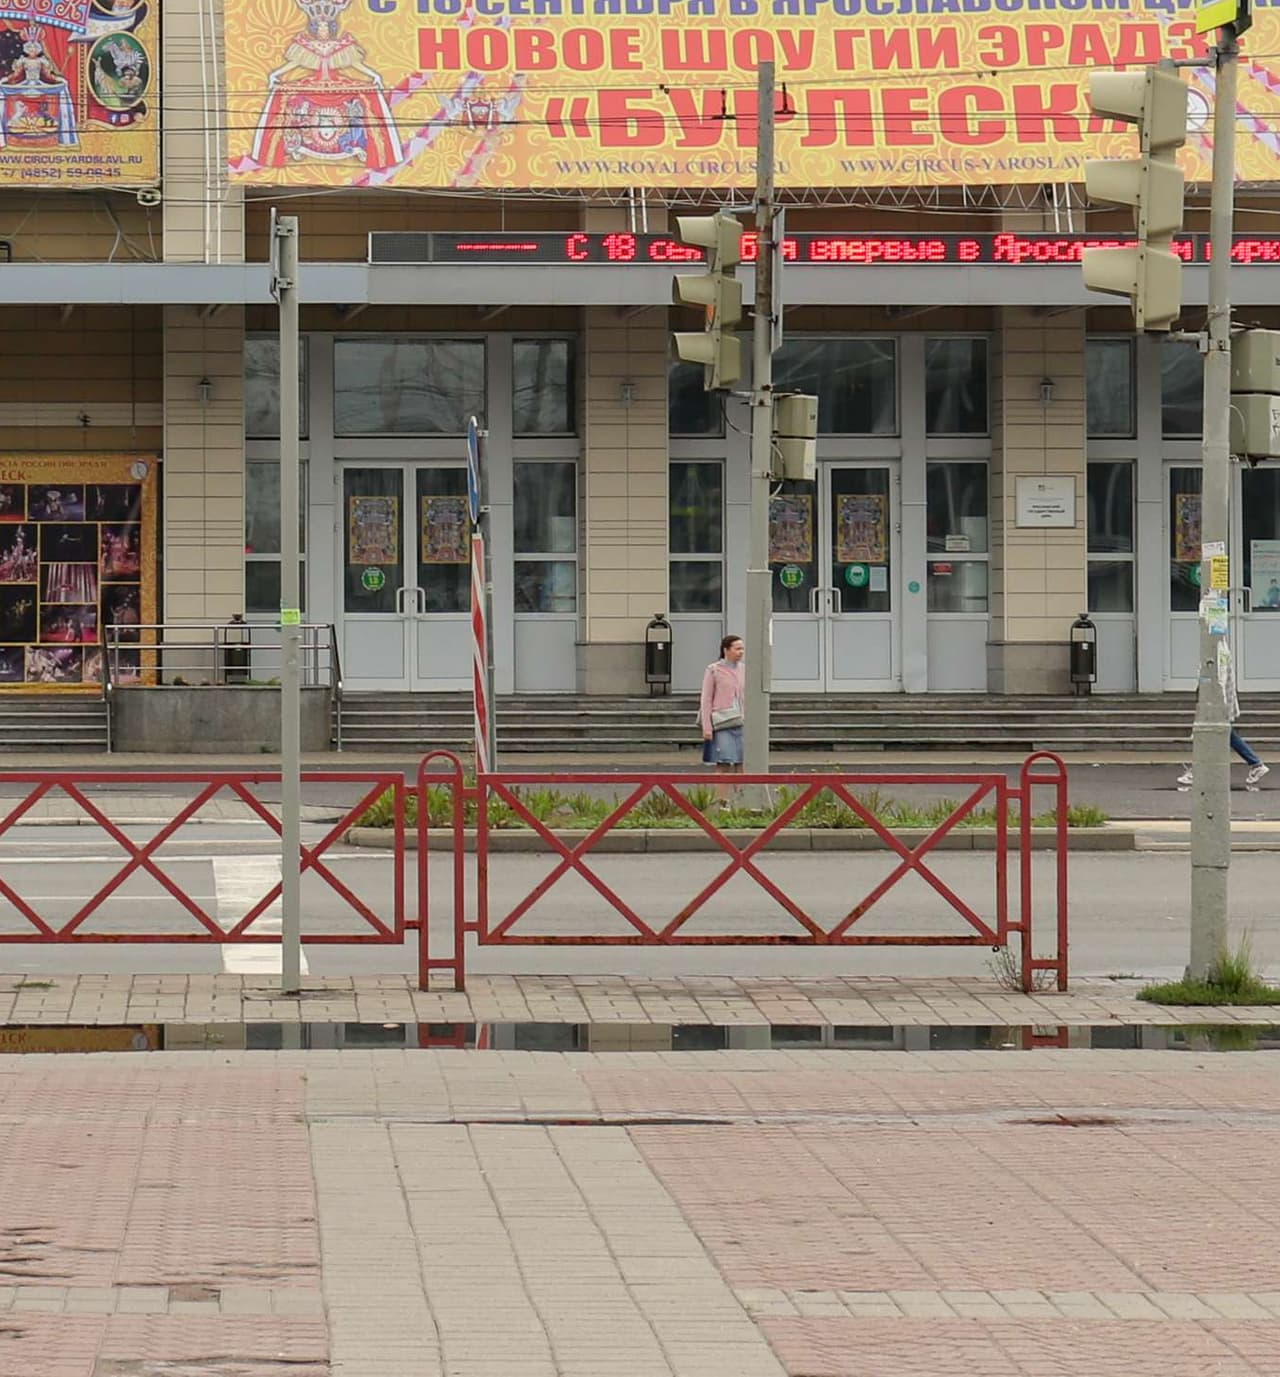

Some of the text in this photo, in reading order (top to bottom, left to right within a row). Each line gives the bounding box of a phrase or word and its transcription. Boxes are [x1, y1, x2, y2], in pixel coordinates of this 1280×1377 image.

[417, 28, 643, 71] НОВОЕ
[661, 27, 815, 71] ШОУ
[834, 26, 960, 71] ГИИ
[556, 159, 791, 175] WWW.ROYALCIRCUSU
[603, 234, 635, 260] 18
[810, 239, 946, 264] впервые
